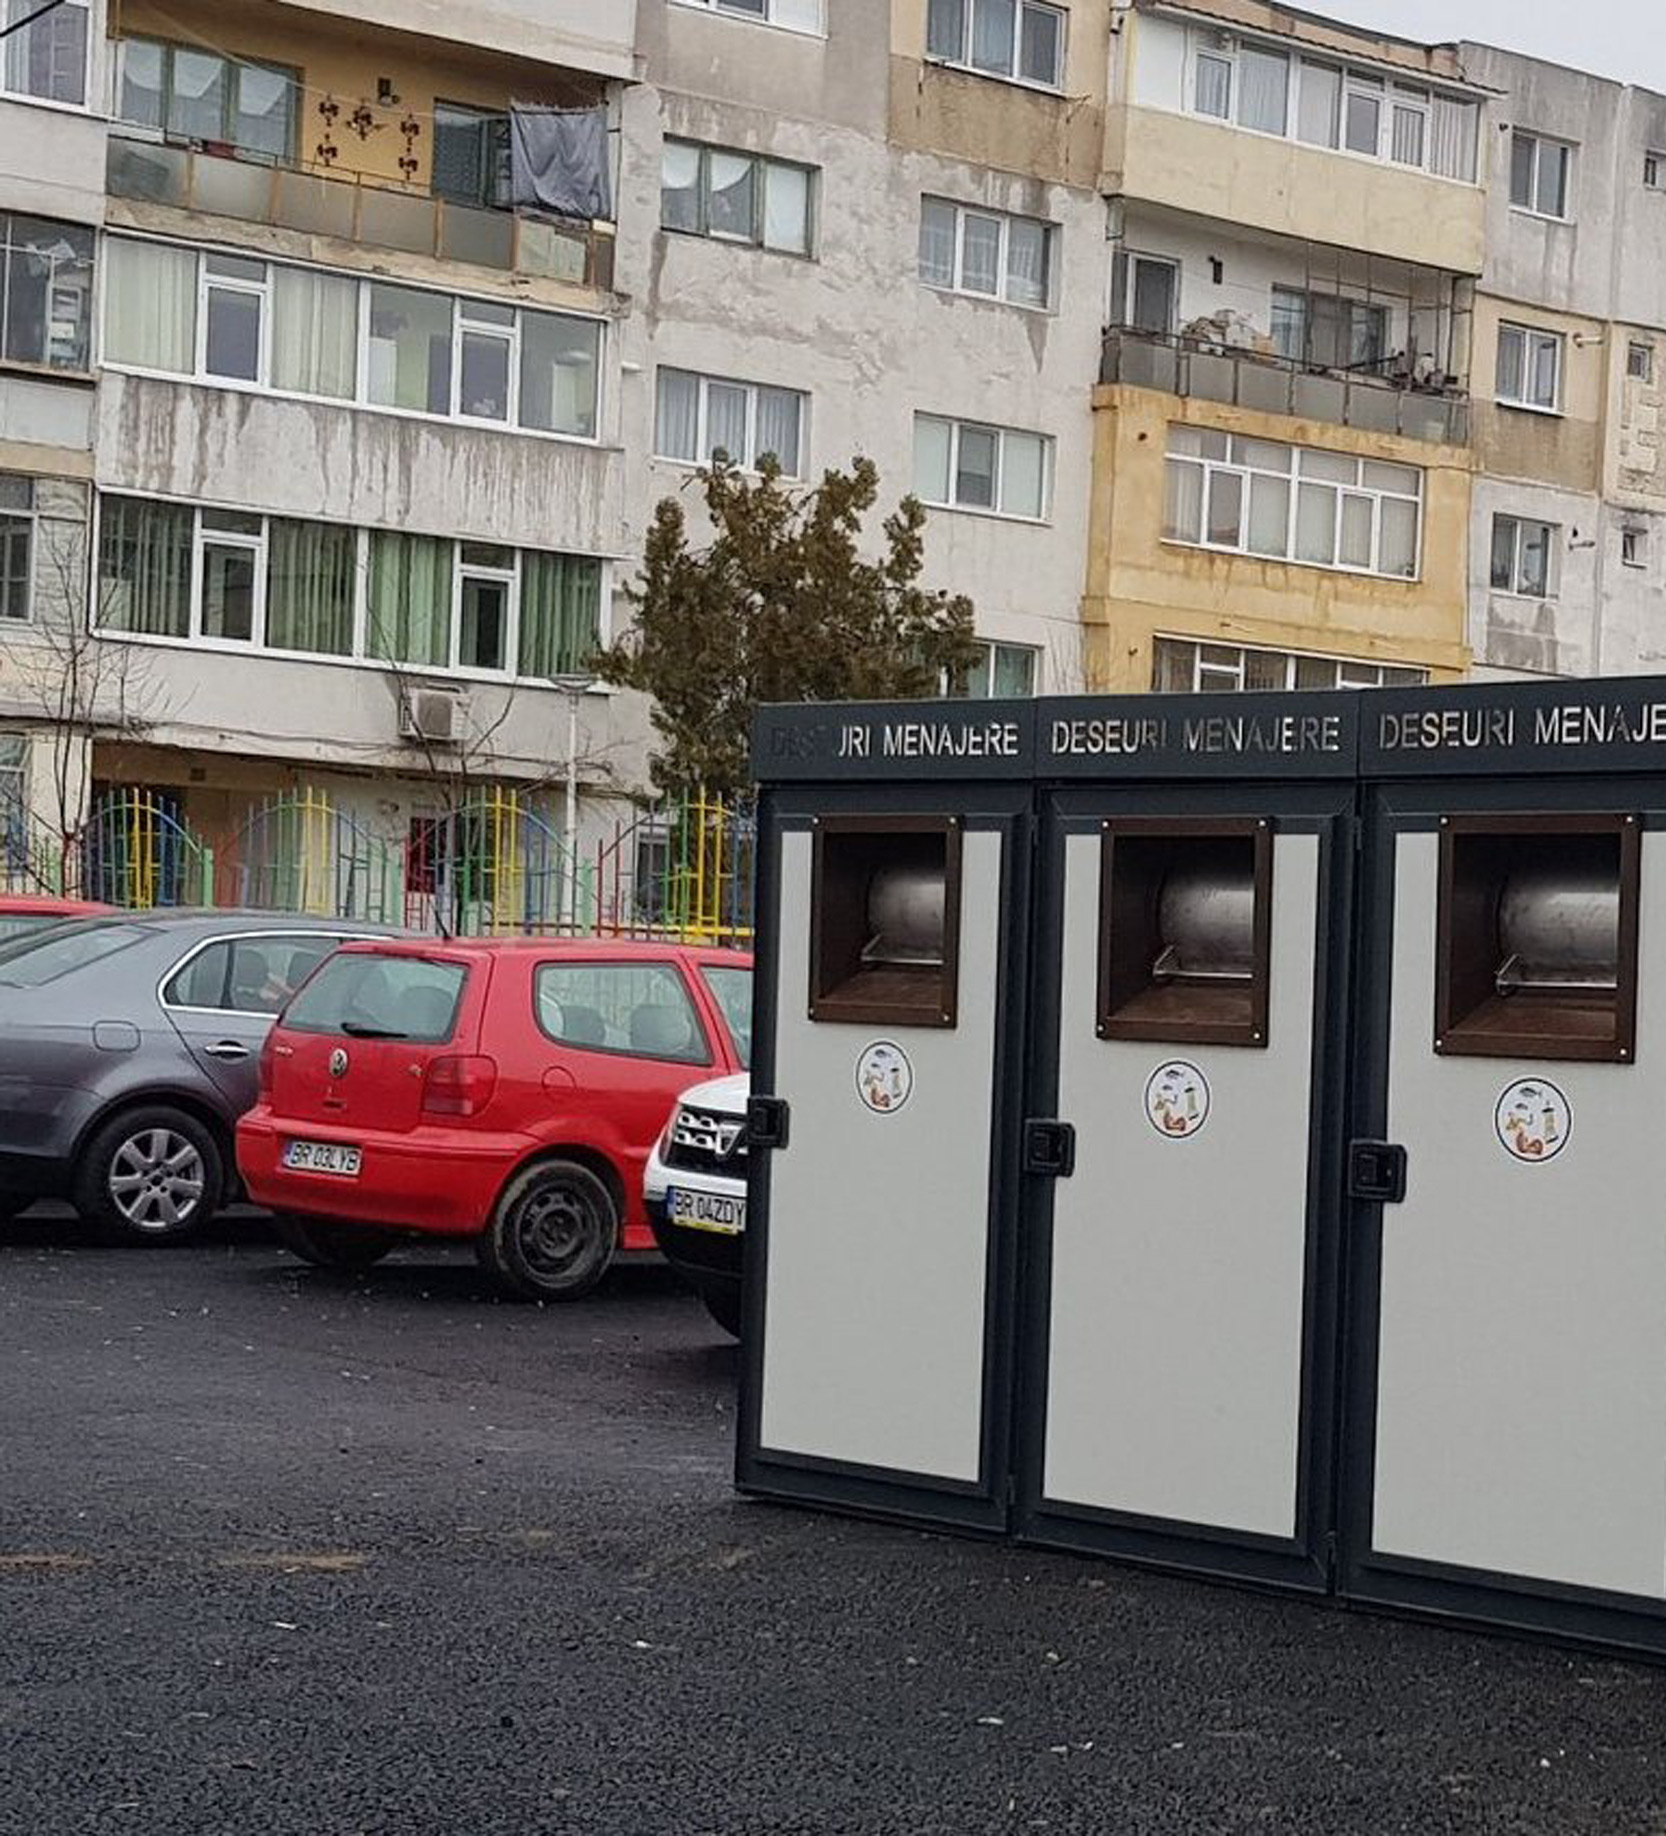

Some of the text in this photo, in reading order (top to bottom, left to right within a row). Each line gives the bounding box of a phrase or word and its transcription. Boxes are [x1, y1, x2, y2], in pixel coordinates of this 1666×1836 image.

[882, 722, 1019, 757] MENAJERE
[1051, 716, 1340, 754] DESEURI MENAJERE
[1378, 708, 1515, 749] DESEURI
[290, 1143, 312, 1164] BR
[675, 1191, 694, 1218] BR
